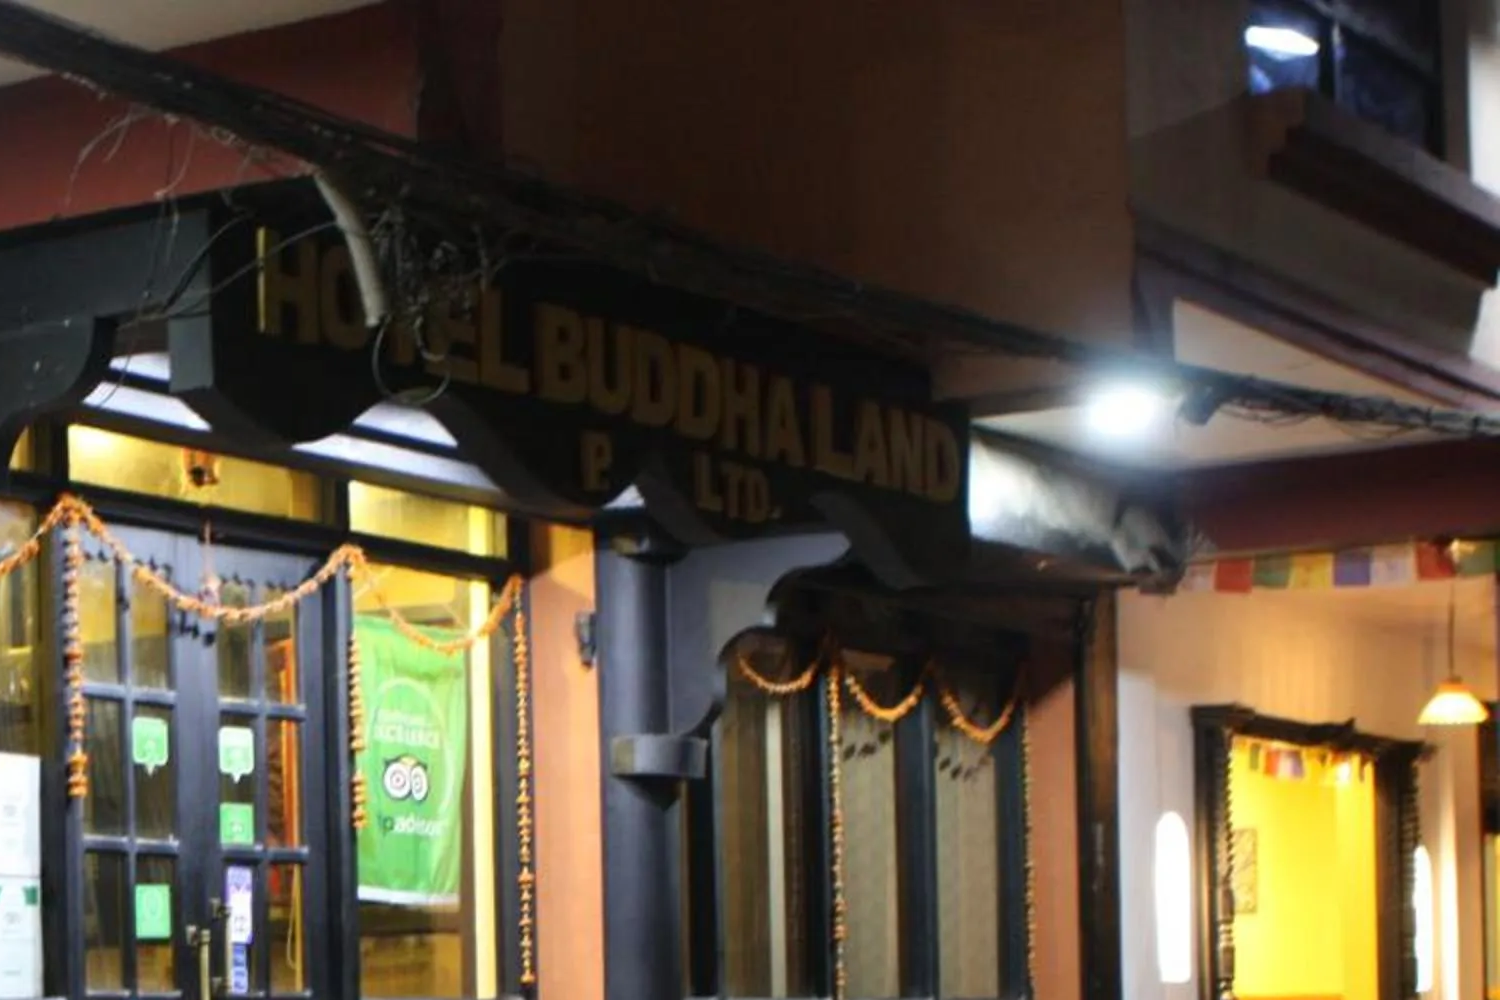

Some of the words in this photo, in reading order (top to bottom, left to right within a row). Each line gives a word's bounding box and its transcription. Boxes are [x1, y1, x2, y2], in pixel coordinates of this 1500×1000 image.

[256, 226, 531, 395] HOEL
[532, 302, 805, 467] BUDDHA
[809, 385, 961, 505] LAND
